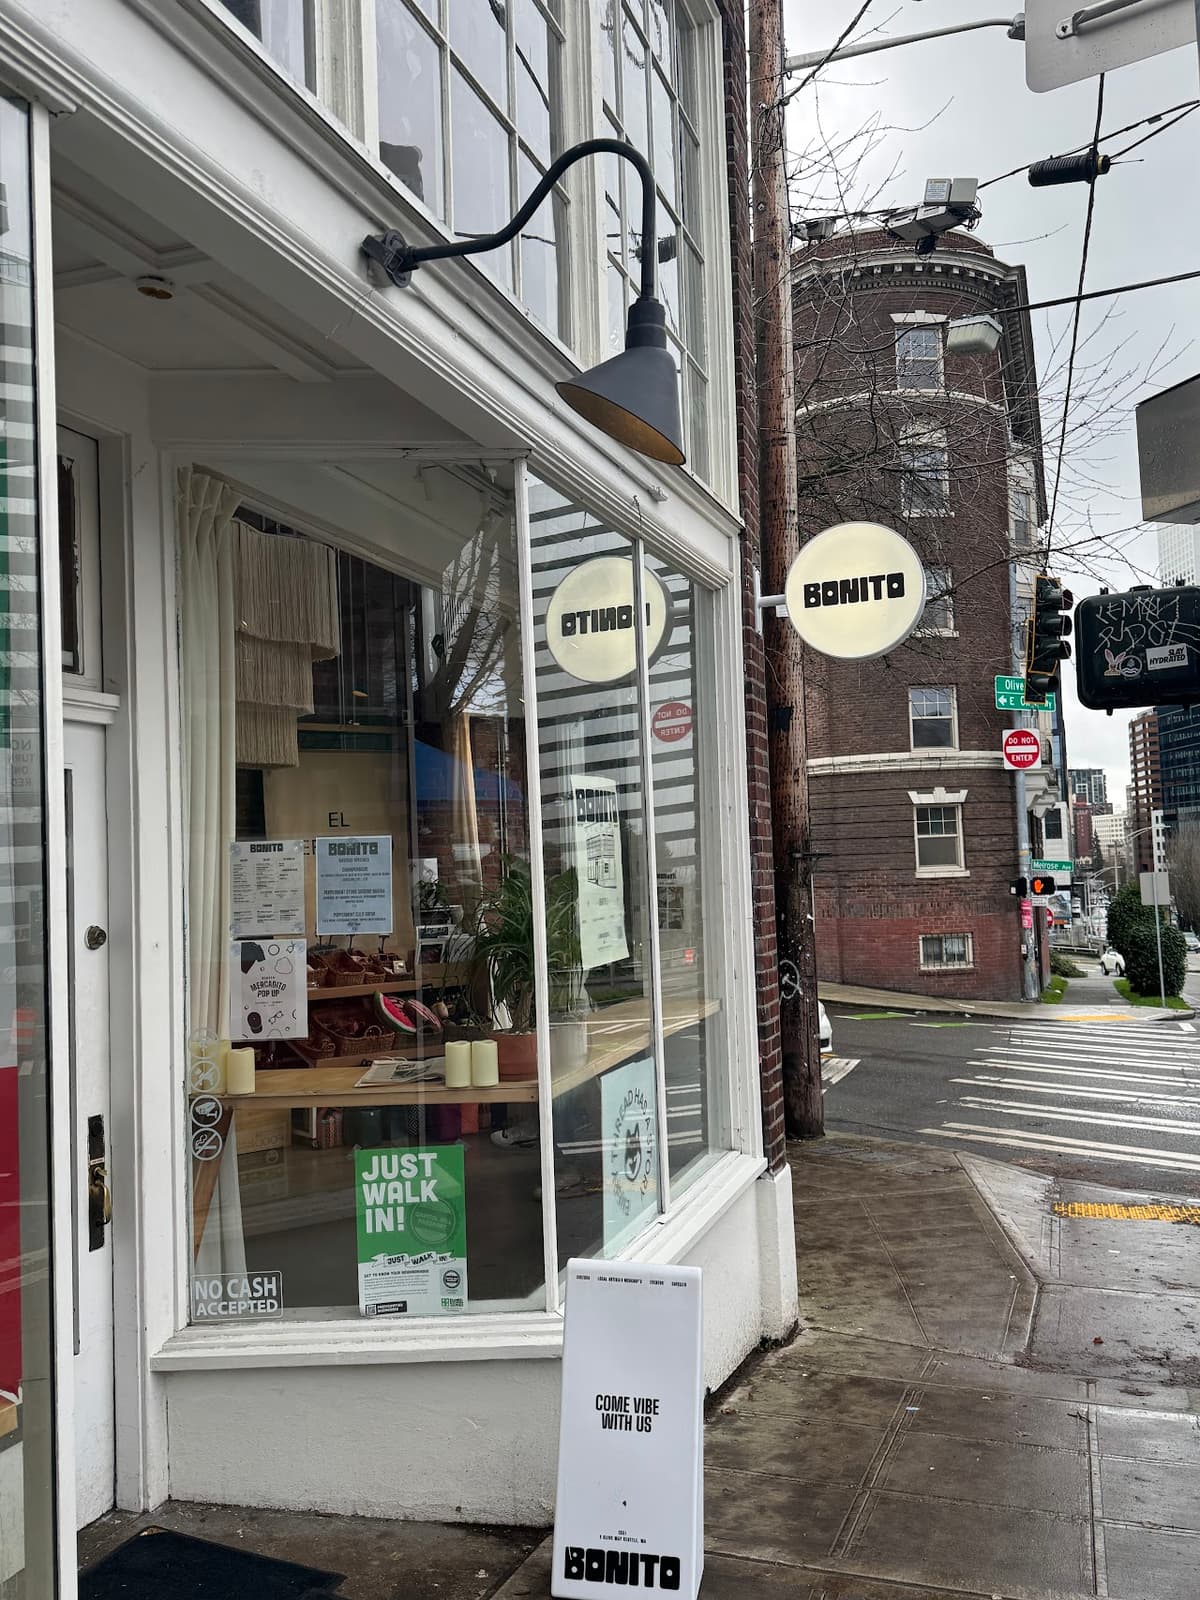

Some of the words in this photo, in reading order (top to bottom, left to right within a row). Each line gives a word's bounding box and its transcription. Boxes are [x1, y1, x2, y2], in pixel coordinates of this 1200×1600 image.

[804, 572, 905, 608] BONITO
[1150, 655, 1186, 665] HYDRATED
[1010, 697, 1015, 705] E
[1008, 737, 1018, 745] DO
[1021, 737, 1035, 745] NOT
[1011, 754, 1033, 762] ENTER
[329, 812, 350, 828] EL
[250, 843, 283, 853] BONITO
[328, 842, 378, 857] BONITO
[1033, 861, 1059, 870] Melrose
[250, 980, 287, 992] MERCADITO
[257, 989, 270, 998] POP
[271, 989, 280, 997] UP
[362, 1152, 438, 1181] JUST
[362, 1179, 439, 1206] WALK
[365, 1207, 405, 1233] IN!
[387, 1255, 405, 1265] JUST
[411, 1252, 434, 1265] WALK
[195, 1278, 223, 1300] NO
[227, 1276, 277, 1299] CASH
[196, 1298, 278, 1316] ACCEPTED
[595, 1394, 630, 1413] COME
[633, 1397, 659, 1416] VIBE
[601, 1412, 632, 1431] WITH
[636, 1414, 652, 1433] US
[564, 1546, 680, 1590] BONITO
